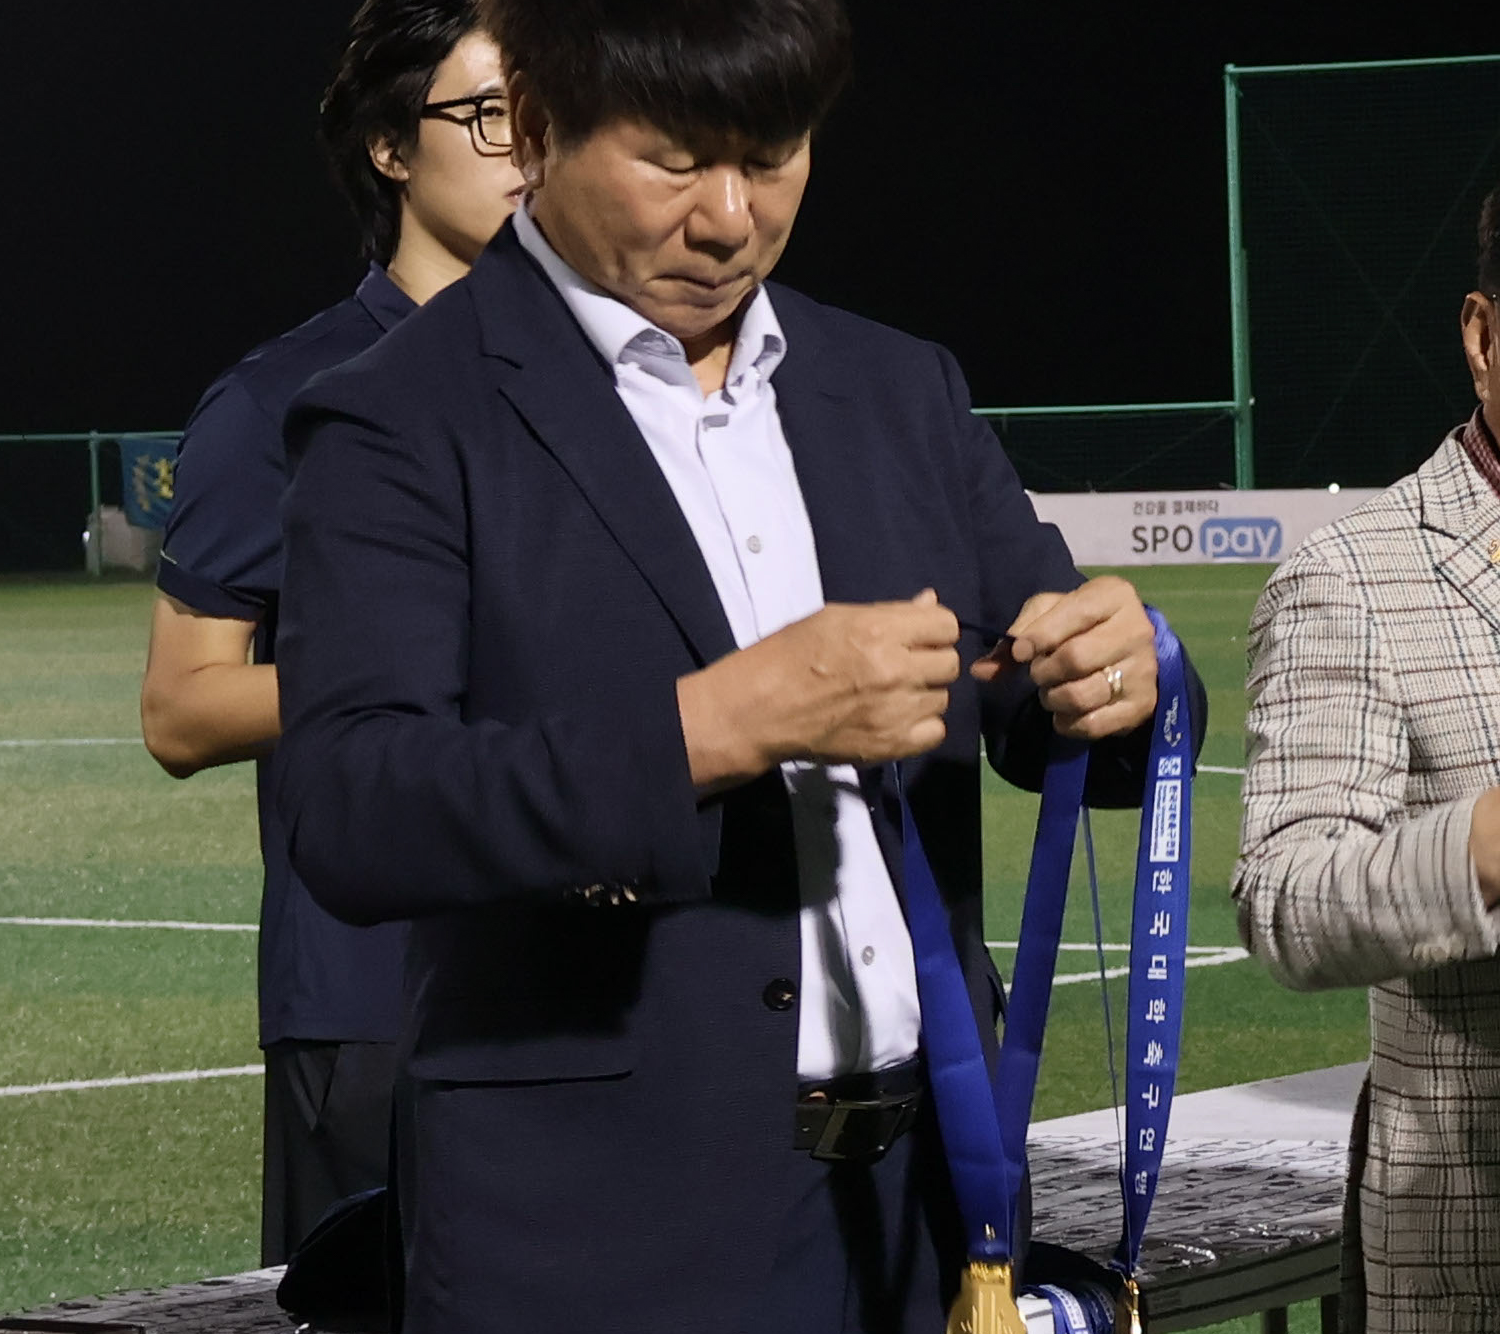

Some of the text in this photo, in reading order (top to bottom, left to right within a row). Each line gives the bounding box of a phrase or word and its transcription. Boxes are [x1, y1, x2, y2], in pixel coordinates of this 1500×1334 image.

[1132, 524, 1278, 559] SPO pay
[1134, 868, 1173, 1196] 한국대학축구연맹
